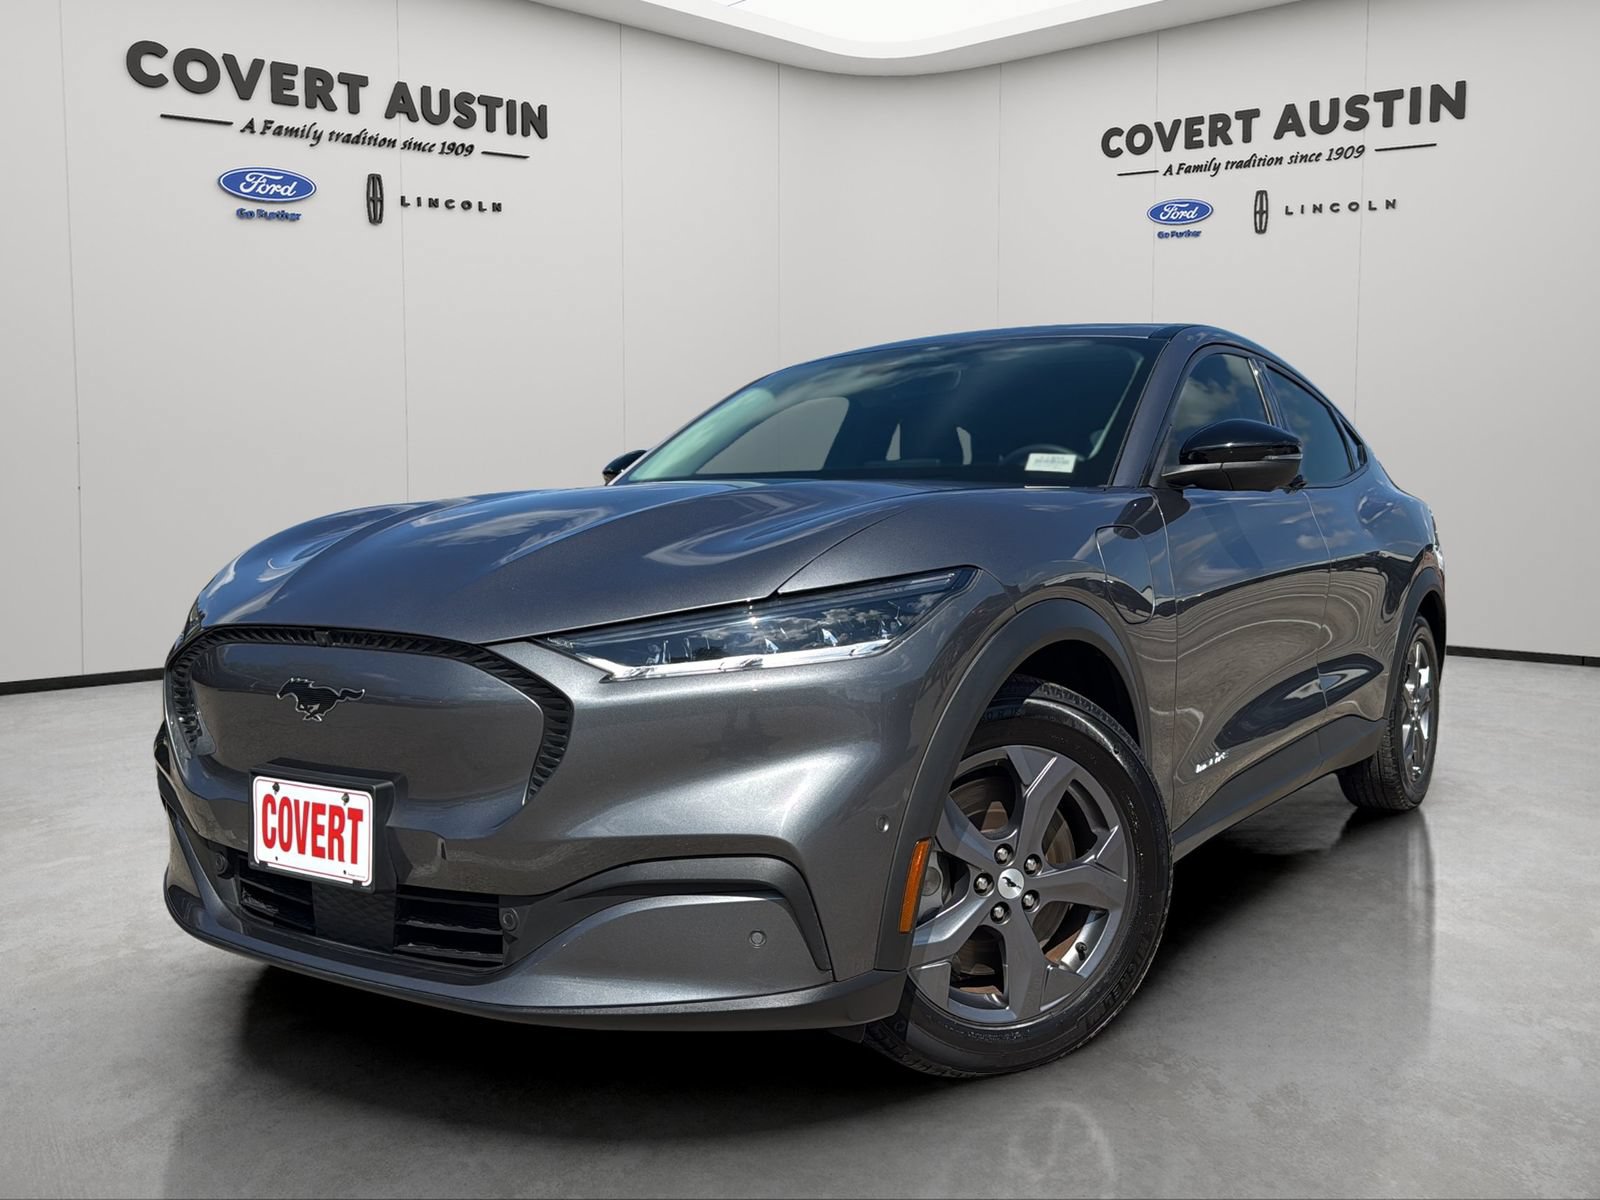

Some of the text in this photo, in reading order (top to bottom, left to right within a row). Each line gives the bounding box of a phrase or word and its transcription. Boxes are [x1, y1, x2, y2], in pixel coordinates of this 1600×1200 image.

[126, 40, 548, 140] COVERT AUSTIN
[1100, 80, 1467, 159] COVERT AUSTIN
[239, 117, 475, 157] A Family tradition since 1909
[1162, 144, 1366, 178] A Family tradition since 1909
[239, 171, 298, 197] Ford
[235, 207, 255, 220] Go
[400, 195, 503, 213] LINCOLN
[1160, 203, 1199, 220] Ford
[1284, 198, 1398, 216] LINCOLN
[1156, 230, 1170, 240] Go
[261, 793, 363, 864] COVERT
